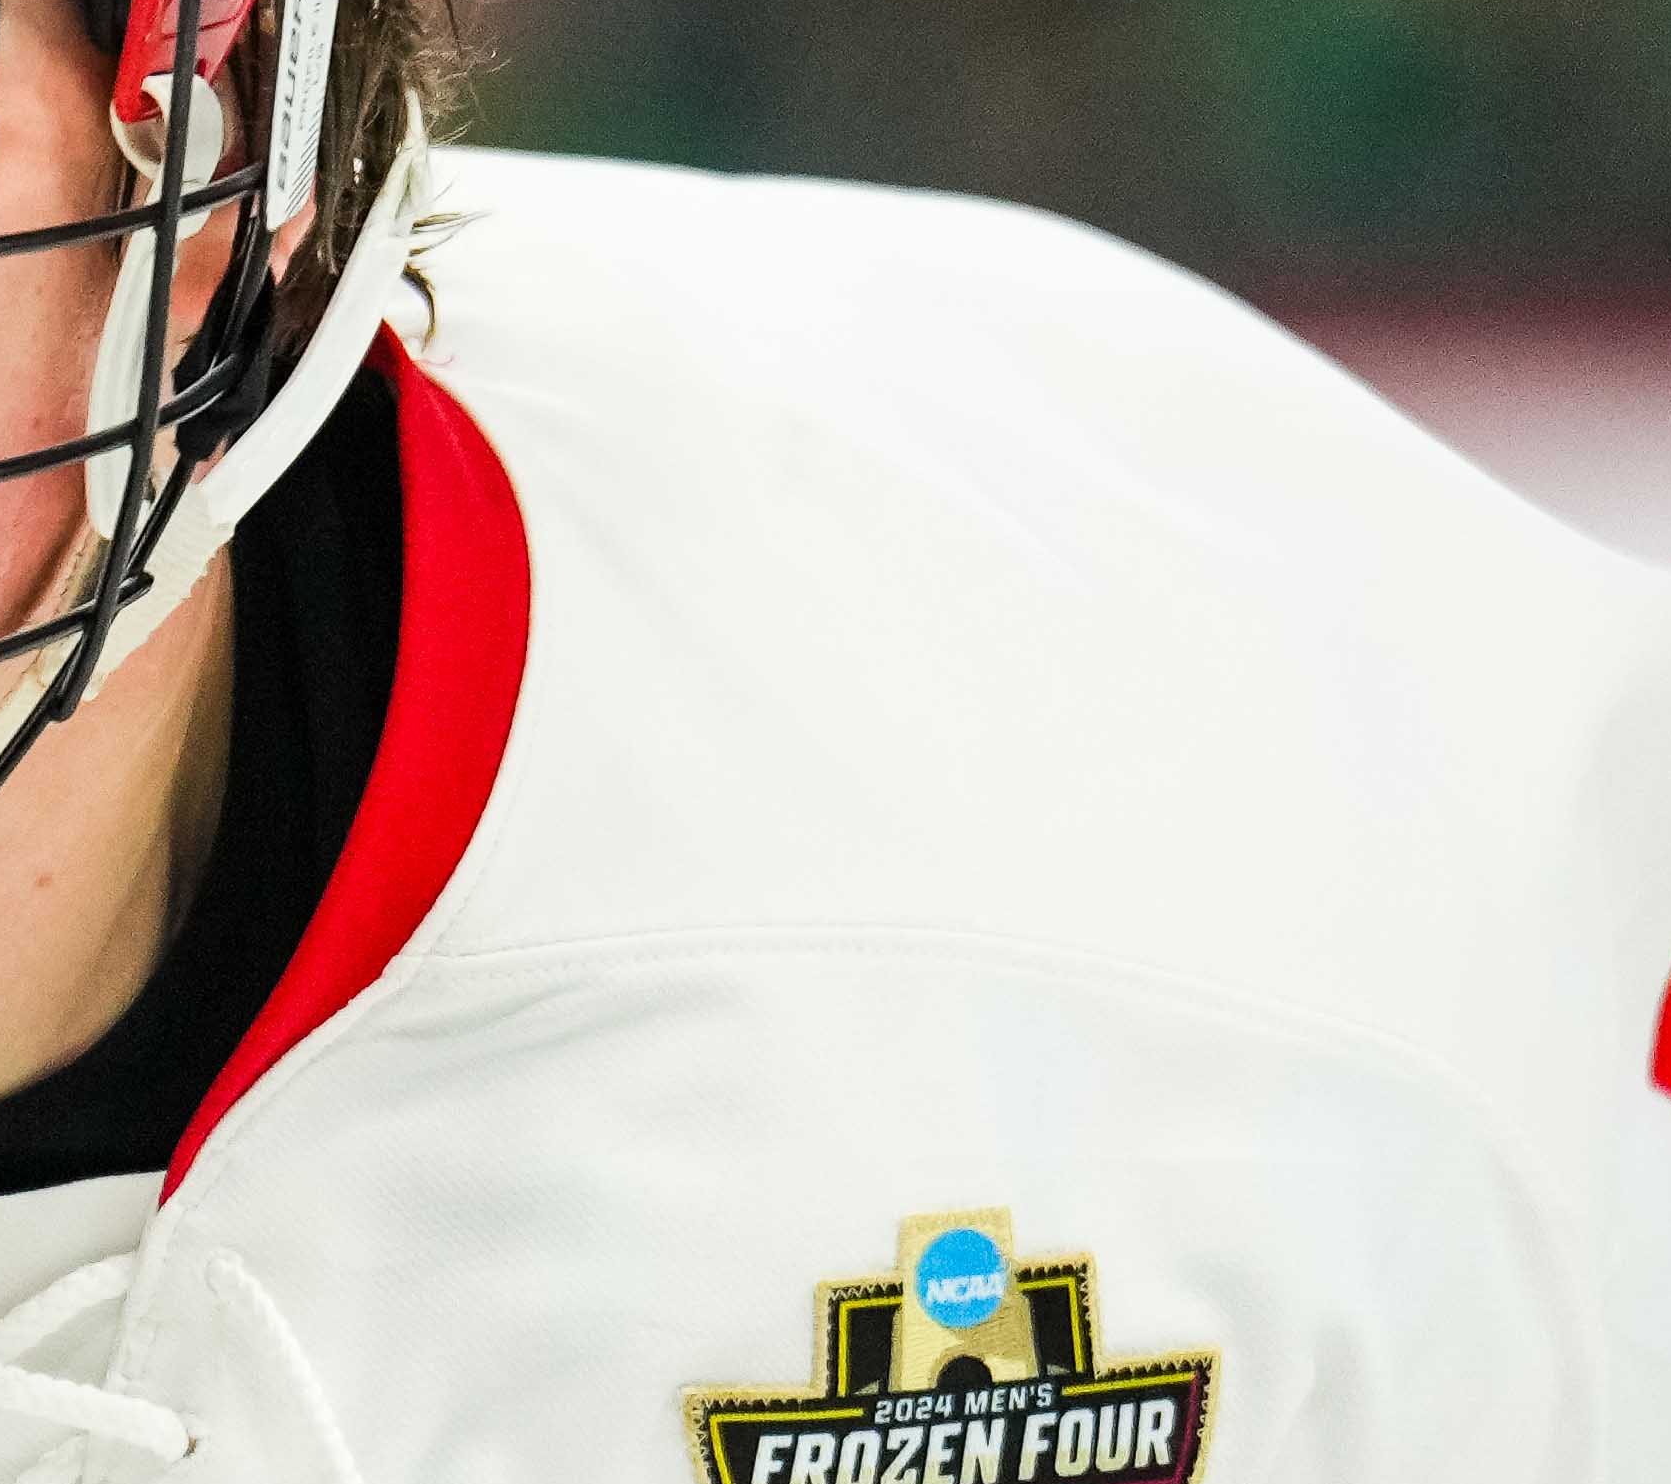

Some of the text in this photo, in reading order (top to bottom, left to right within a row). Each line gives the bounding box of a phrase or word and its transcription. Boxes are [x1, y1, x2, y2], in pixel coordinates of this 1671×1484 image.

[924, 1270, 1009, 1306] NCAA
[873, 1381, 1054, 1426] 2024 MEN'S
[1016, 1397, 1180, 1482] FOUR
